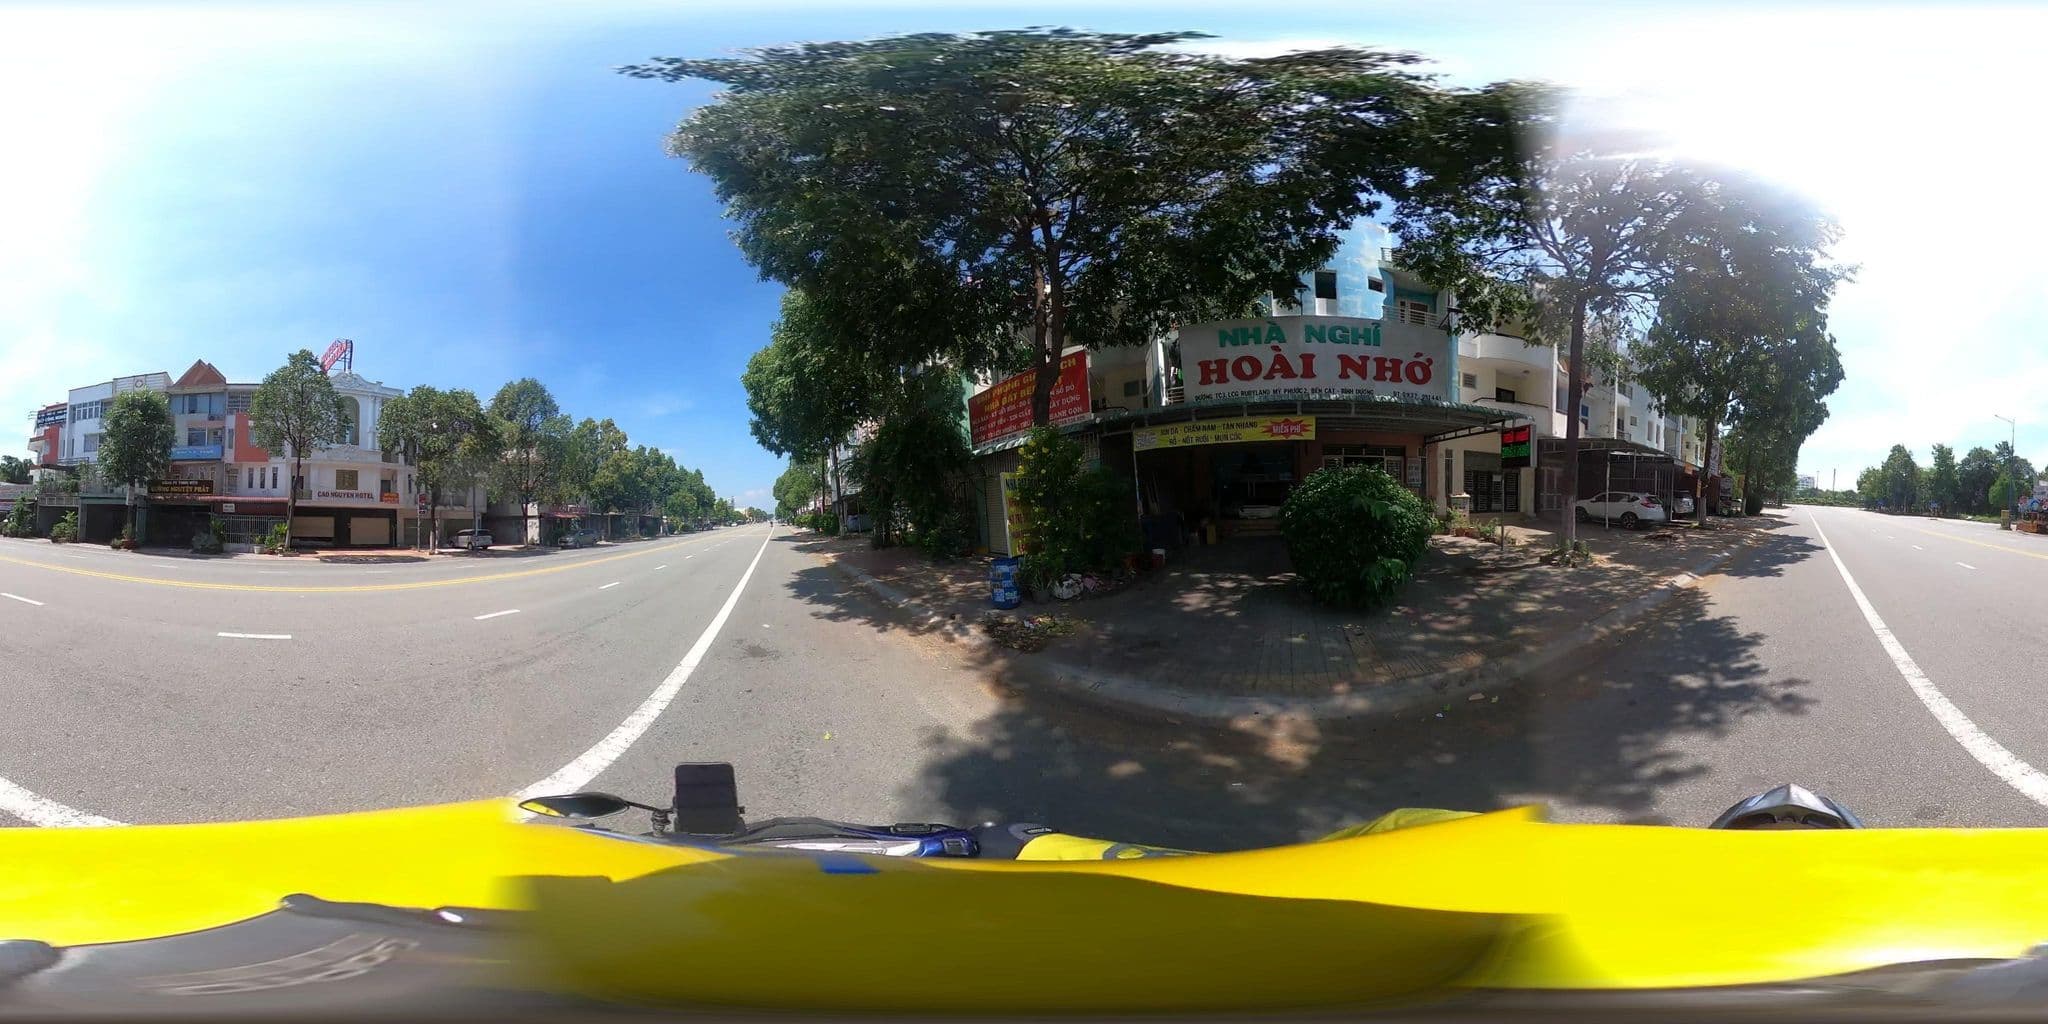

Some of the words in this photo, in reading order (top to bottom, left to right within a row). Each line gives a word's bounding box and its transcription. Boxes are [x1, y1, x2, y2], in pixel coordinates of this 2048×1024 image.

[1218, 322, 1286, 347] NHÀ
[1304, 322, 1382, 347] NGHỈ
[1198, 345, 1317, 385] HOÀI
[1337, 352, 1434, 385] NHỚ
